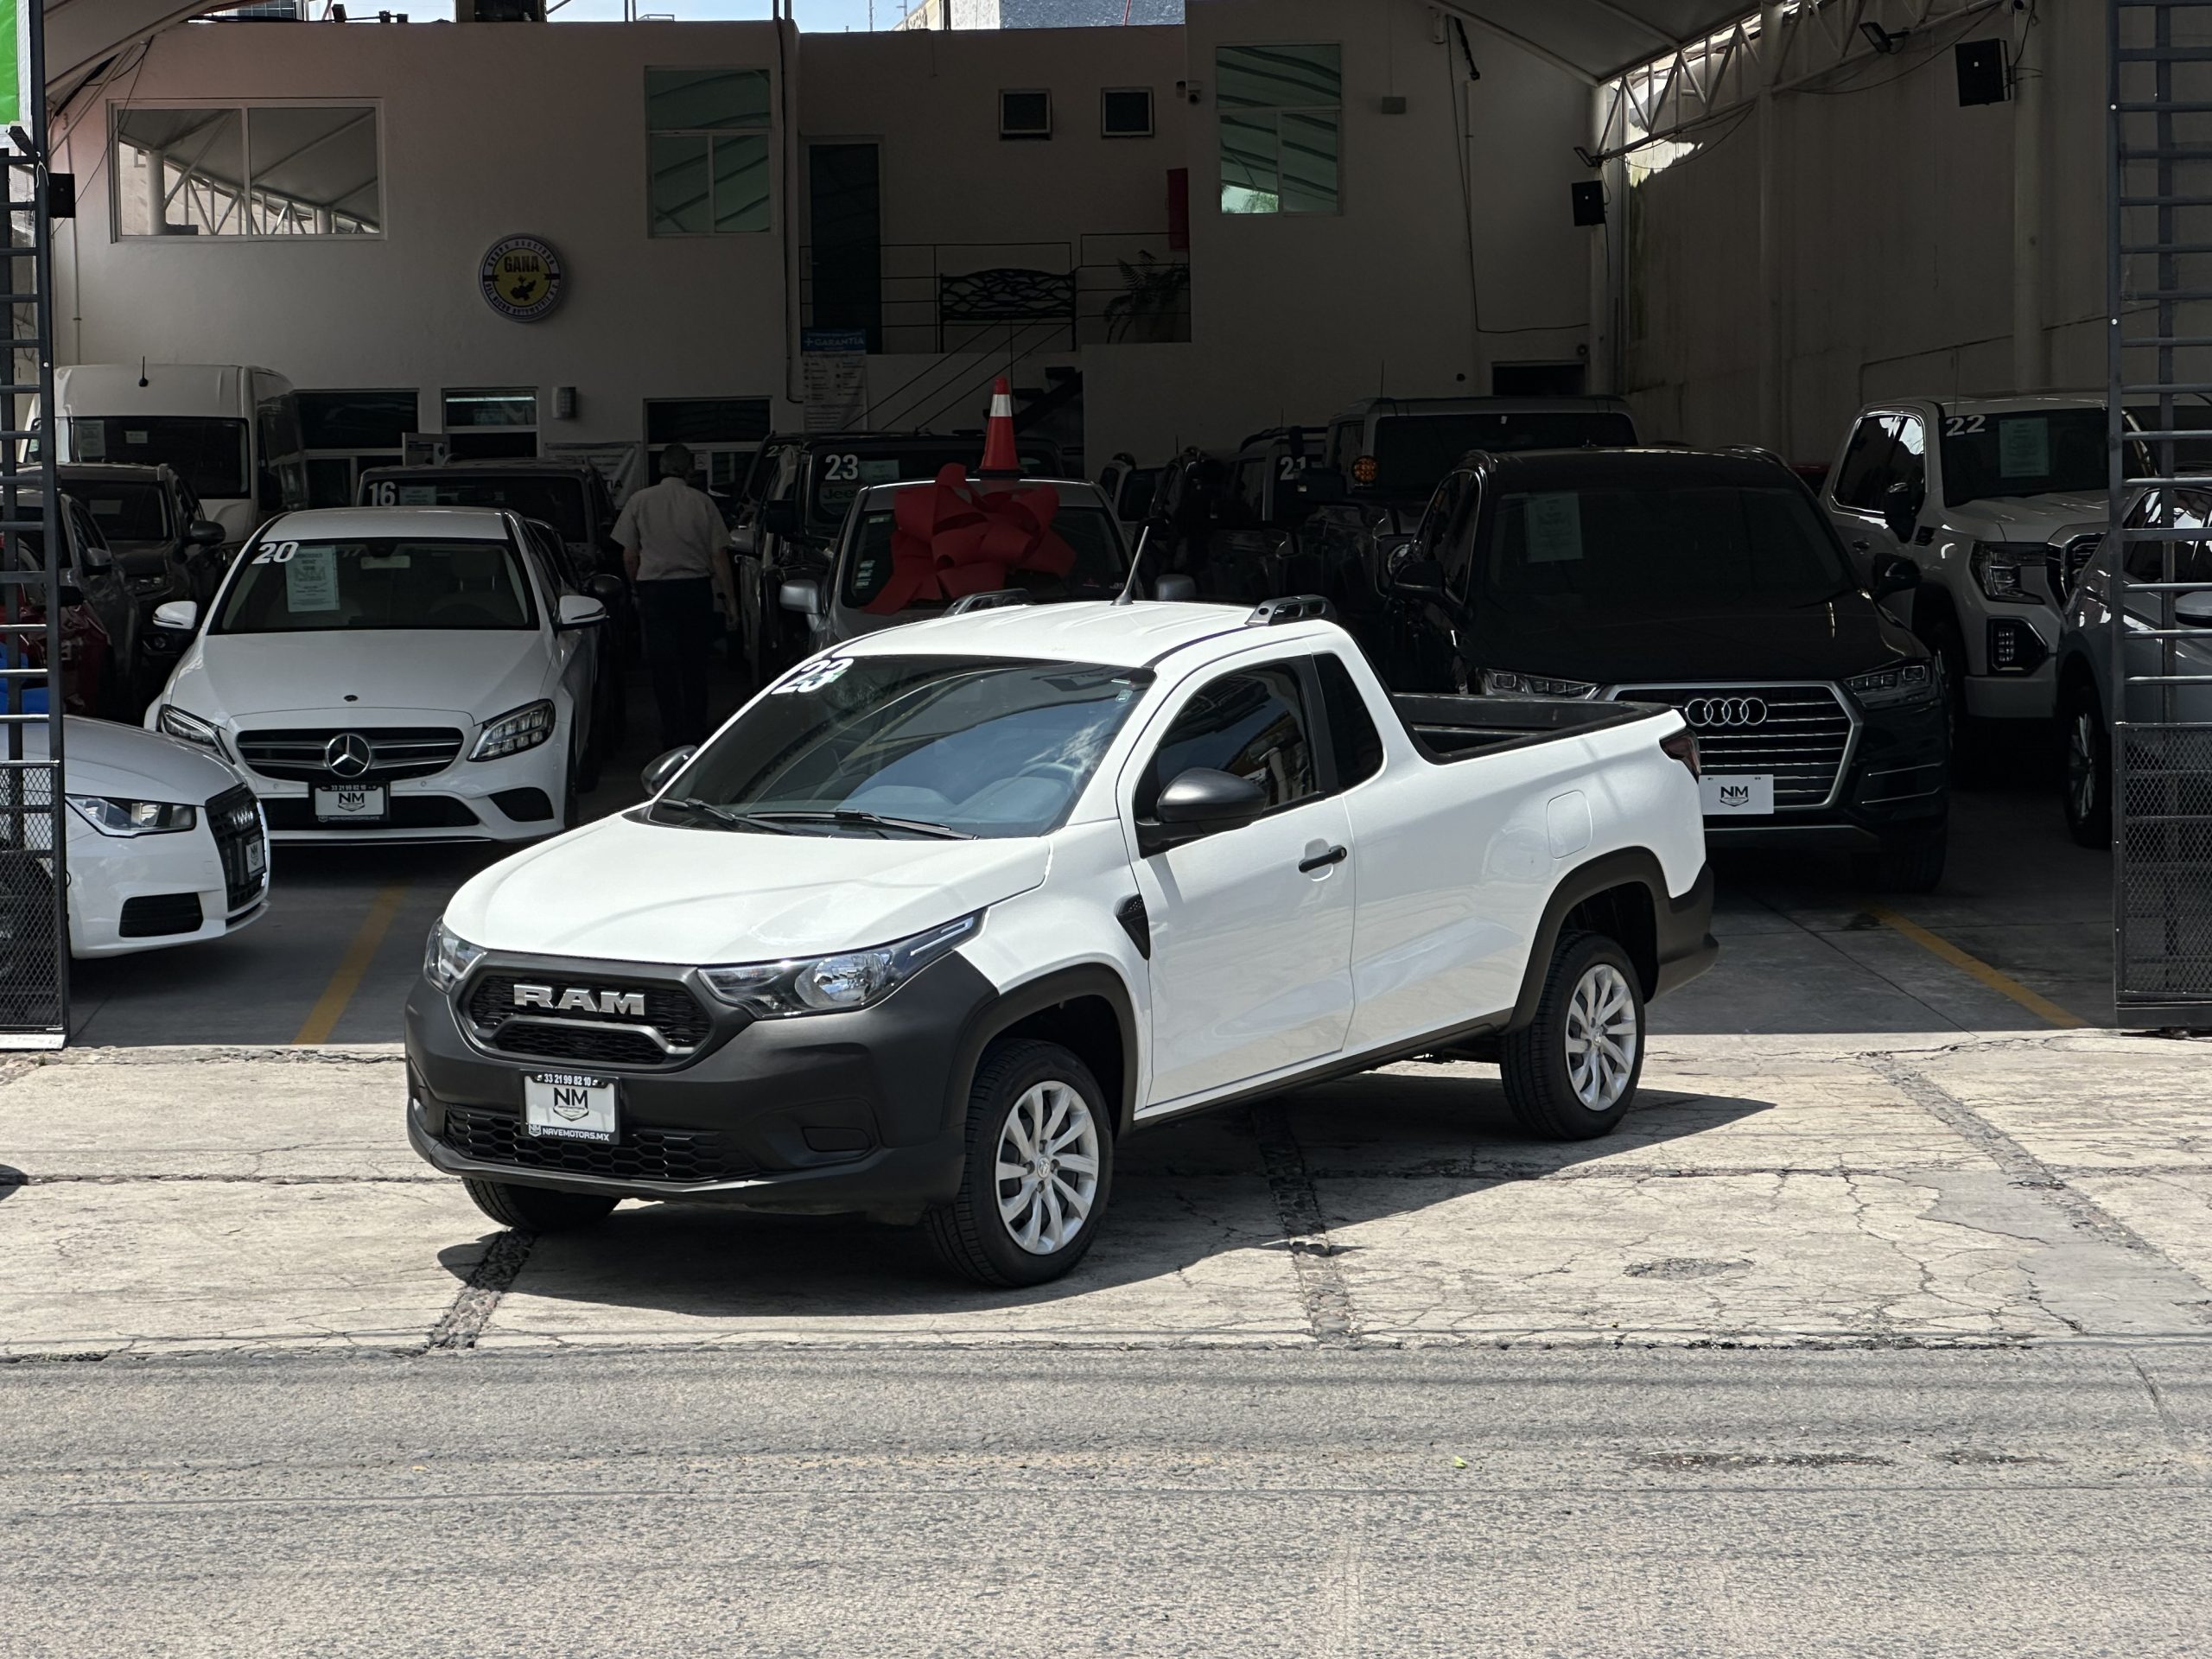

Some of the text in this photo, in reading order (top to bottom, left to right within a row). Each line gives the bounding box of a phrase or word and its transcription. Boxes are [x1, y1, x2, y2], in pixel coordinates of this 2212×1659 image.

[504, 256, 539, 273] GANA
[1945, 414, 1986, 437] 22
[824, 454, 859, 481] 23
[368, 480, 397, 506] 16
[251, 541, 300, 565] 20
[770, 658, 855, 696] 23
[339, 792, 365, 804] NM
[1720, 785, 1749, 798] NM
[514, 984, 645, 1016] RAM
[543, 1073, 592, 1086] 33 21 99 82 10
[553, 1087, 588, 1109] NM
[542, 1127, 610, 1141] NAVEMOTORS.MX
